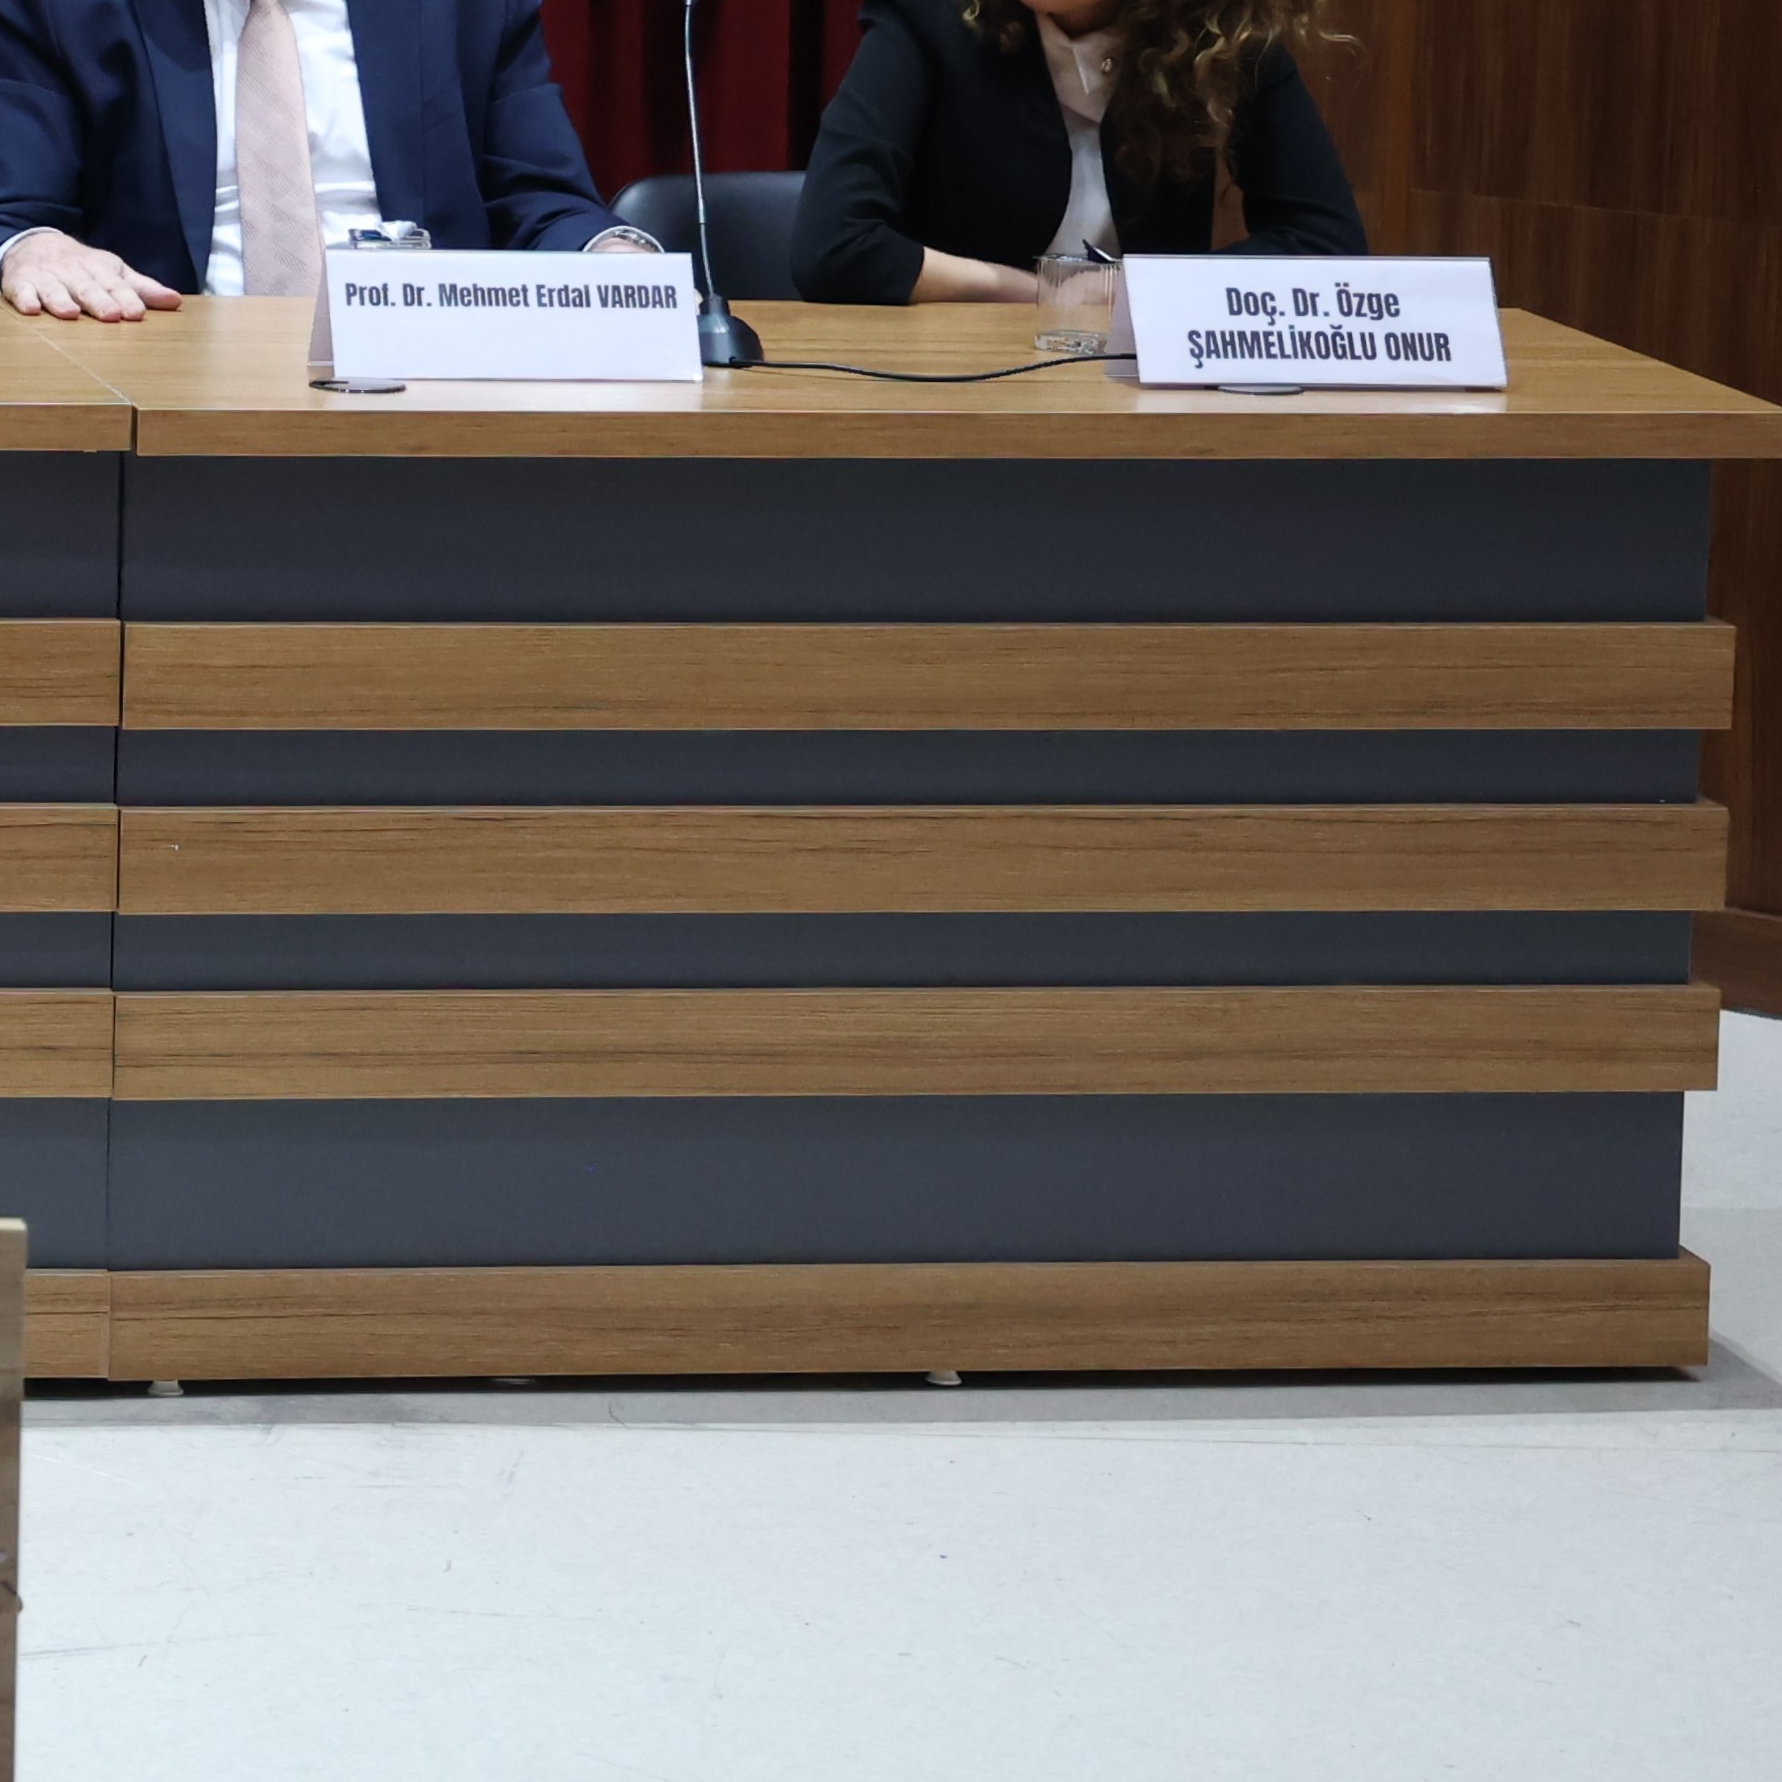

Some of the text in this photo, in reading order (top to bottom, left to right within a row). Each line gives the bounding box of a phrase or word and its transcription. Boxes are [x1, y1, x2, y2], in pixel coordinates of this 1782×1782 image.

[344, 282, 678, 309] Prof. Dr. Mehmet Erdal VARDAR
[1225, 282, 1401, 326] Doç. Dr. Özge
[1187, 325, 1452, 369] ŞAHMELİKOĞLU ONUR
